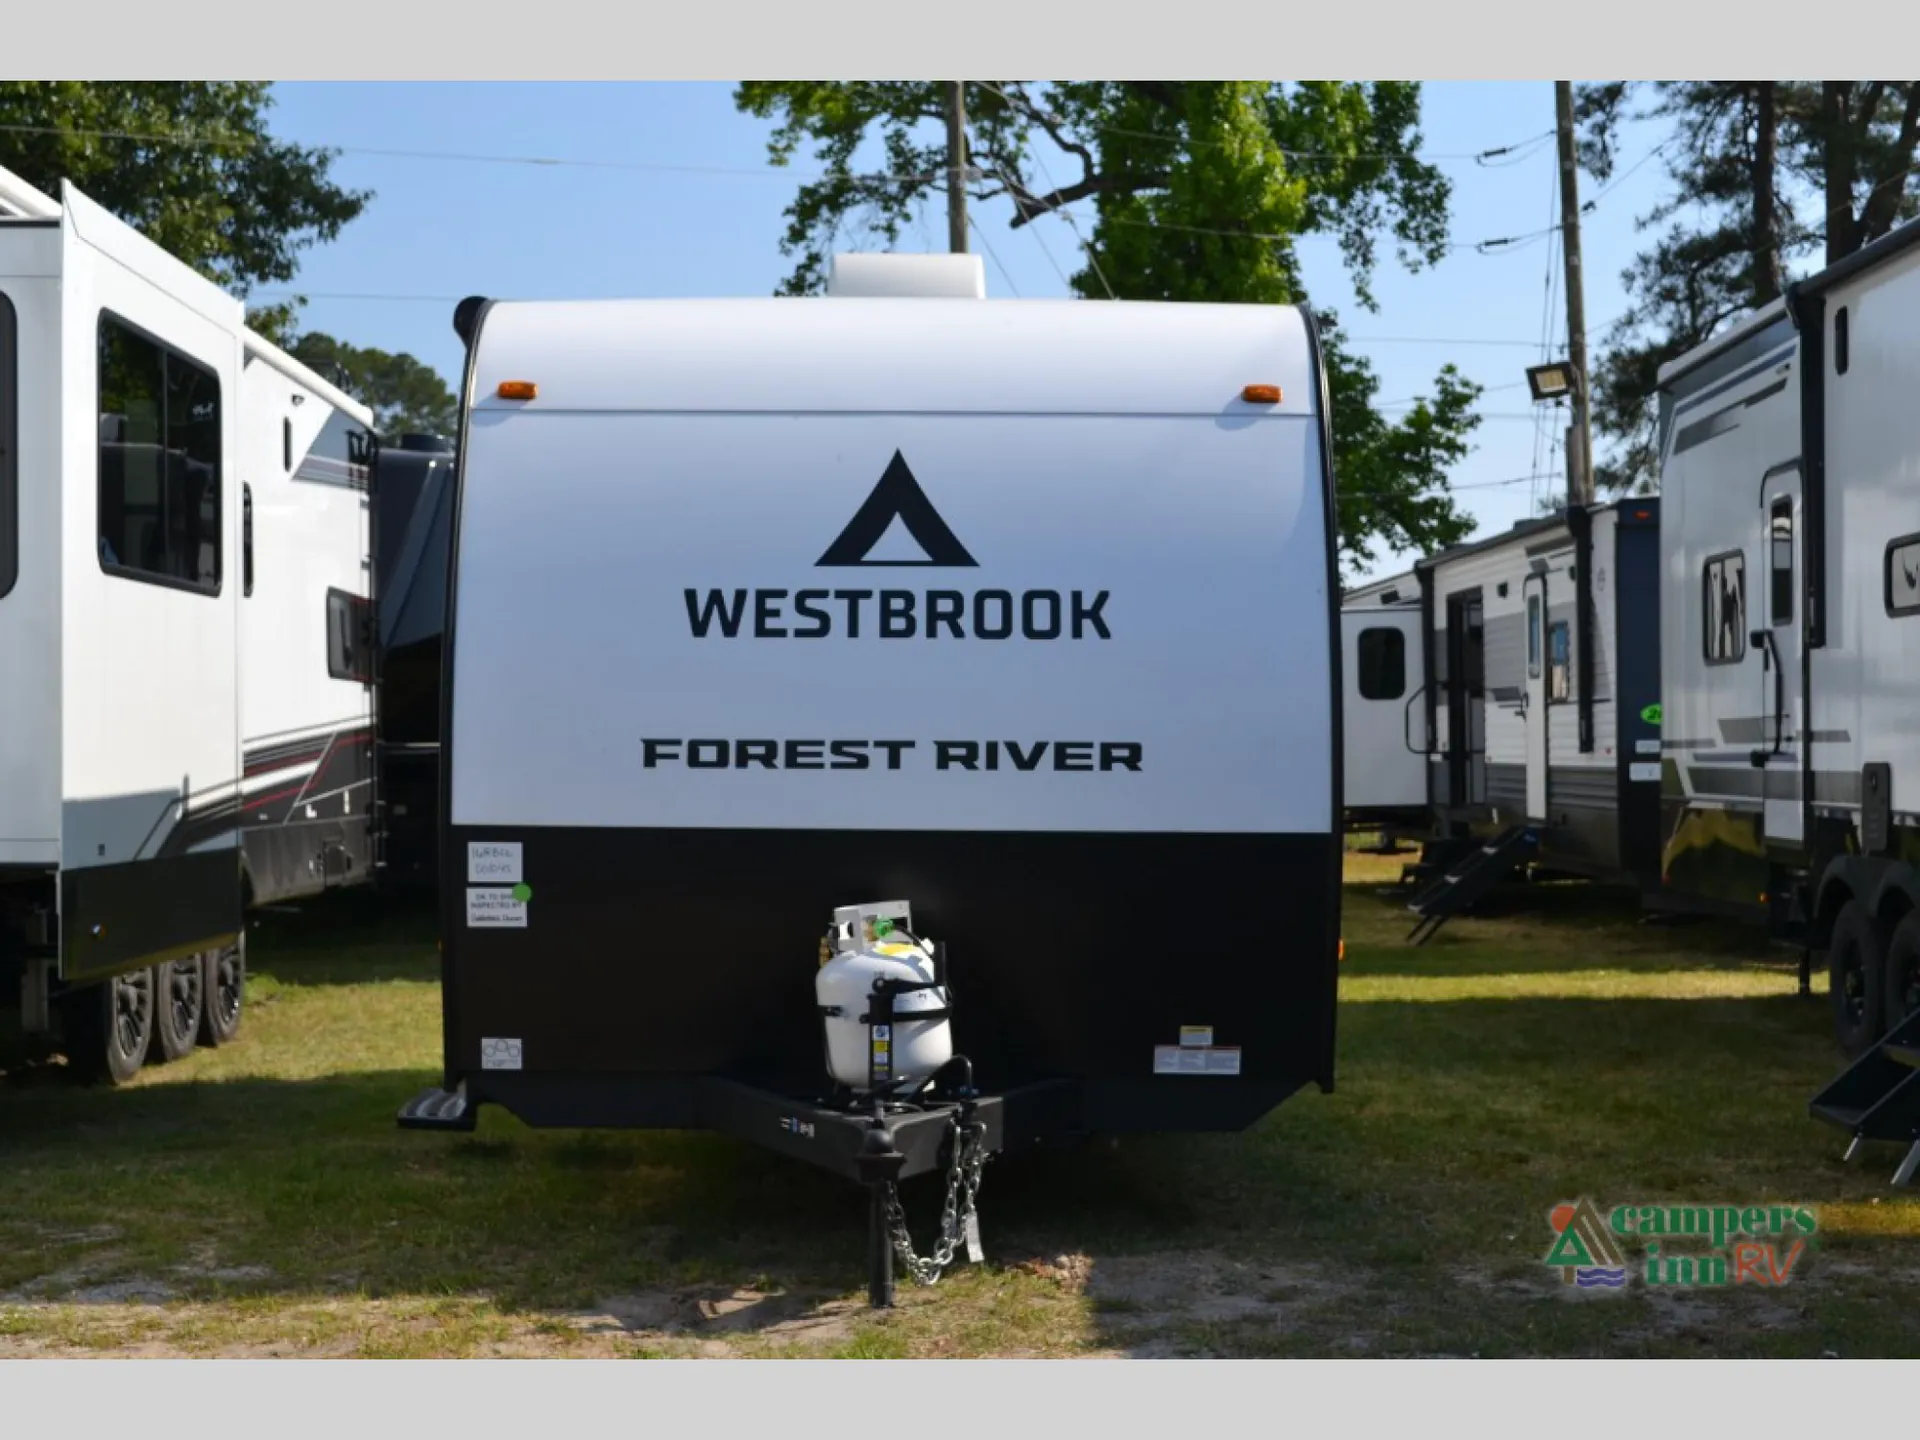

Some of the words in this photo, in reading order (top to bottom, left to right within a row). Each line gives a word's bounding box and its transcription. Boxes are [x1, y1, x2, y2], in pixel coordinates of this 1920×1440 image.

[683, 588, 1112, 640] WESTBROOK
[640, 737, 916, 771] FOREST
[933, 739, 1144, 772] RIVER
